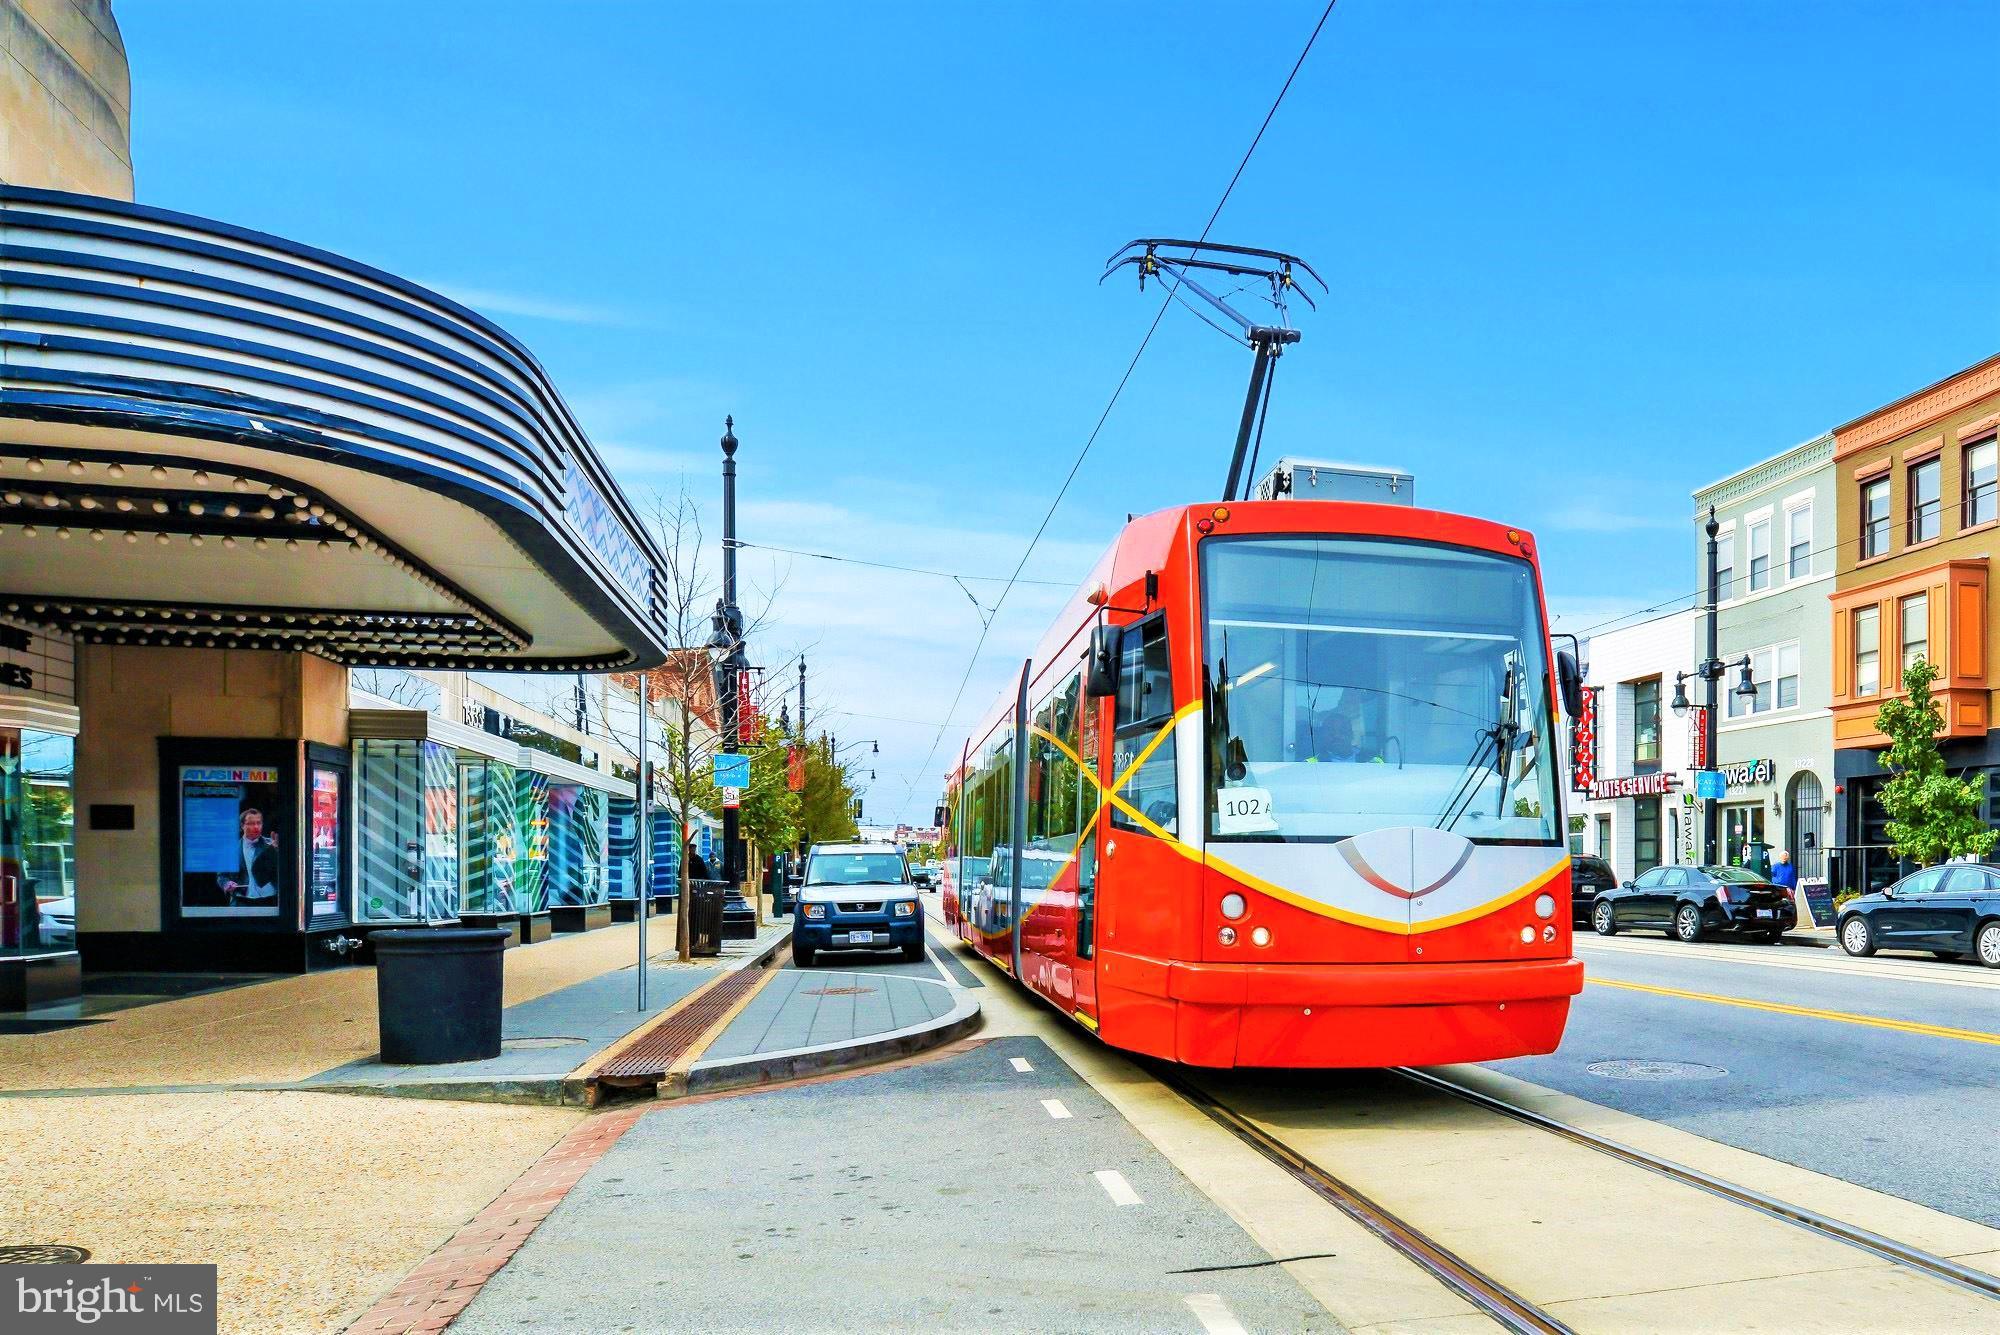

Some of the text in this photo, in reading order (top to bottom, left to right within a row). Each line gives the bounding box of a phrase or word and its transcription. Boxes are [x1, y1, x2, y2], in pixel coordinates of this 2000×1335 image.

[1718, 759, 1770, 785] wafel
[1593, 779, 1620, 798] PARTS
[1627, 775, 1667, 795] SERVICE
[1226, 799, 1261, 817] 102
